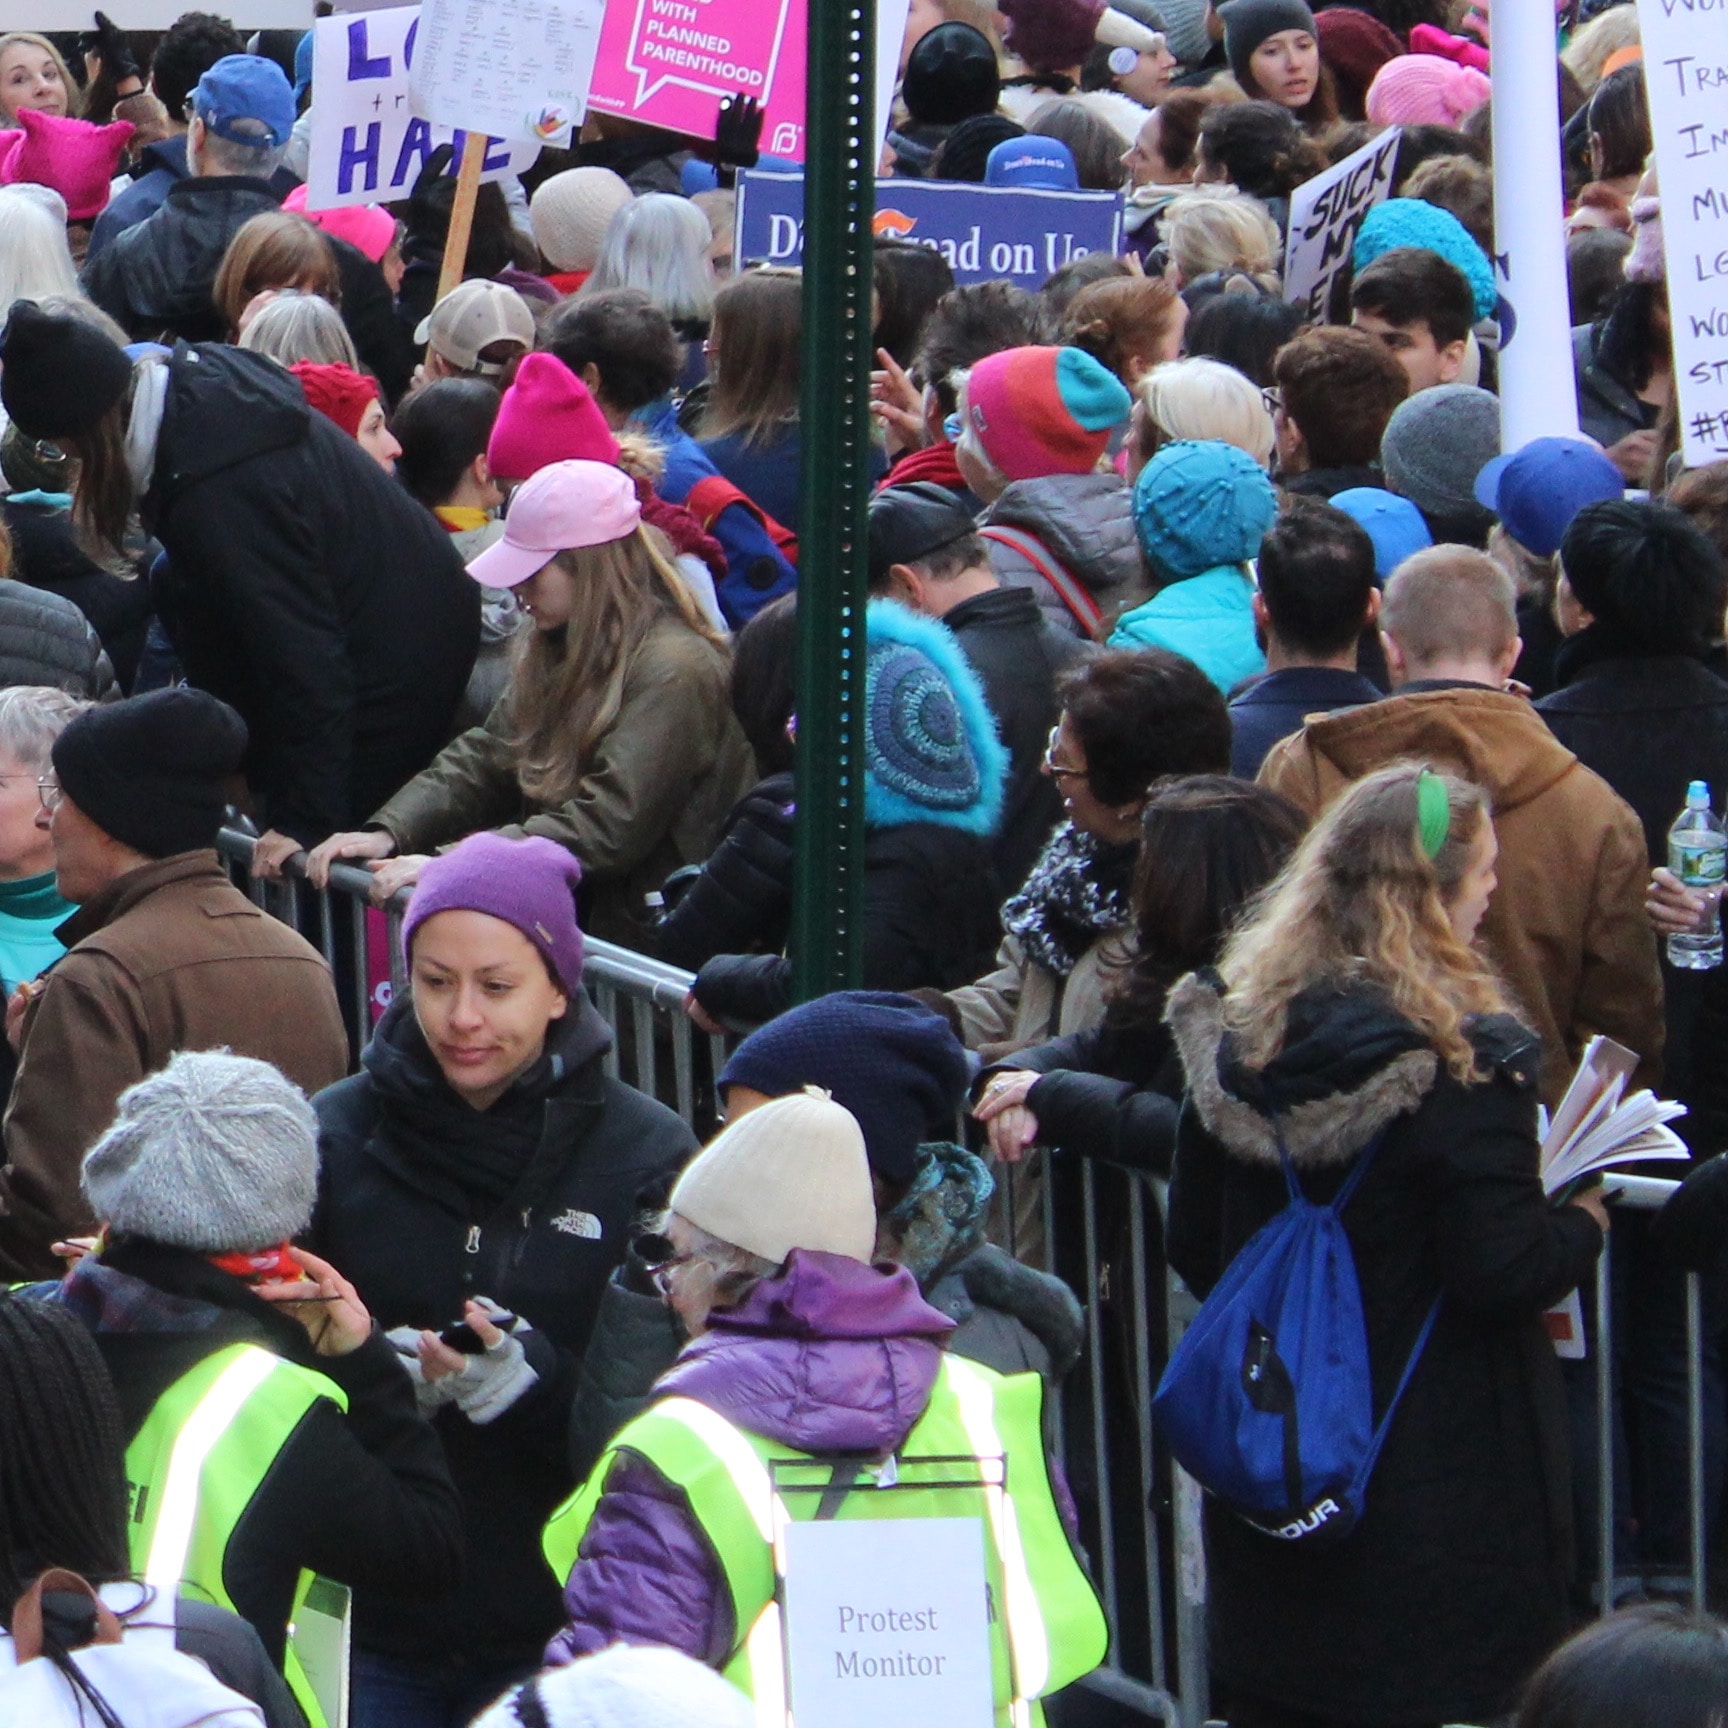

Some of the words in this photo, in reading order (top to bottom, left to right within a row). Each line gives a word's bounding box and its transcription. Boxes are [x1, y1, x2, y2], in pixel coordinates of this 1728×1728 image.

[646, 18, 733, 55] PLANNED
[641, 41, 765, 88] PARENTHOOD
[1303, 137, 1398, 241] SUCK
[990, 243, 1036, 276] on
[566, 1208, 587, 1221] THE
[838, 1602, 938, 1636] Protest
[836, 1648, 947, 1682] Monitor
